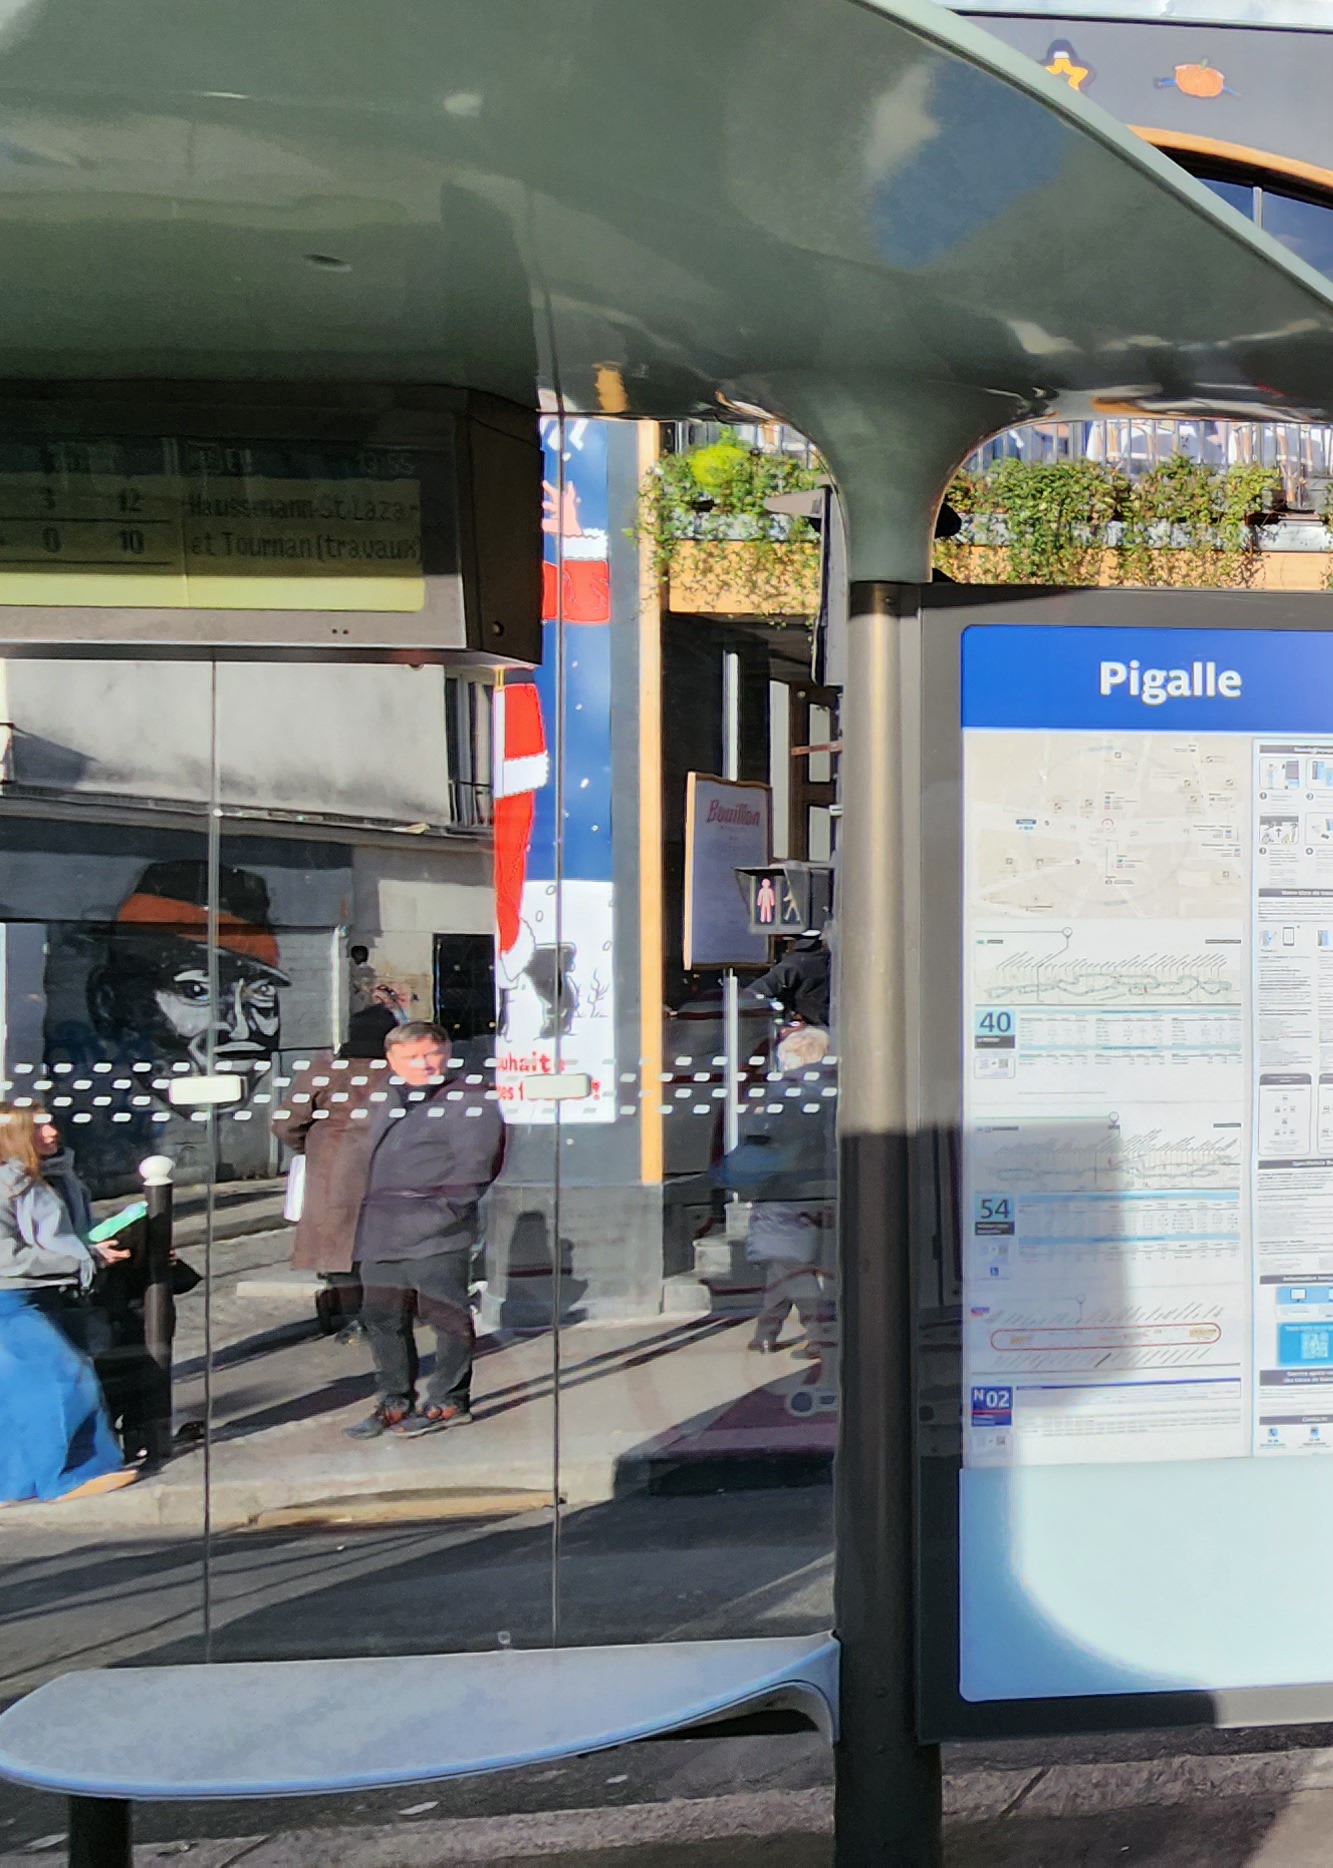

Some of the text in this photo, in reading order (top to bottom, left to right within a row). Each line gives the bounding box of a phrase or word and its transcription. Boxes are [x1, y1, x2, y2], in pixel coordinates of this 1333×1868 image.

[1100, 660, 1242, 705] Pigalle
[706, 799, 761, 827] Bouillon
[980, 1011, 1011, 1033] 40
[981, 1198, 1010, 1219] 54
